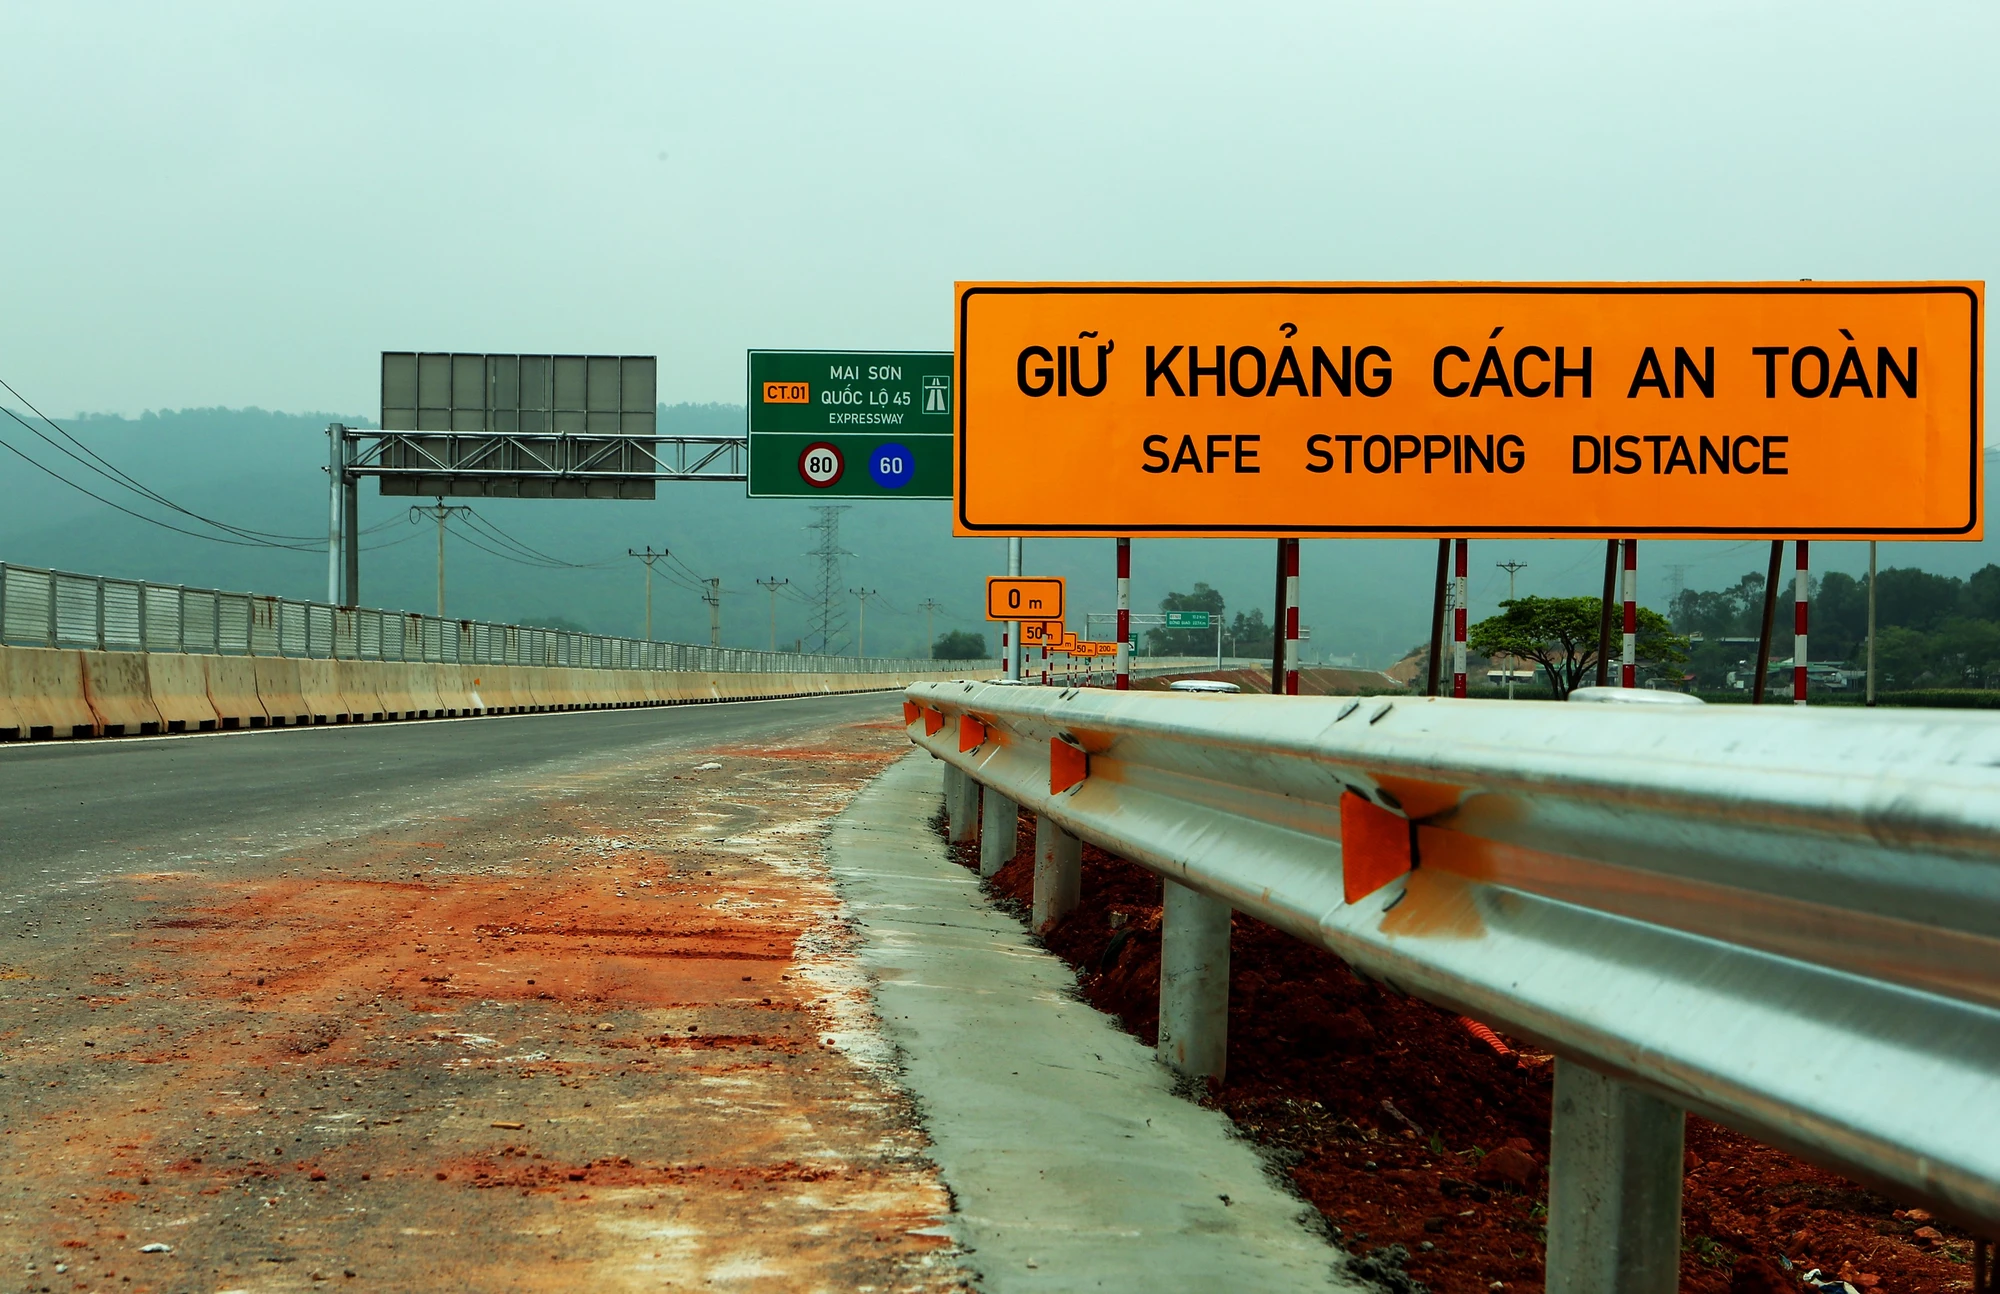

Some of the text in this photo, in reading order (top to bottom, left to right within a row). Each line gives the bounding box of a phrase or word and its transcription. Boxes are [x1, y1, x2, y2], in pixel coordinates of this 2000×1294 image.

[1016, 322, 1918, 398] GIỮ KHOẢNG CÁCH AN TOÀN
[830, 364, 902, 380] MAI SƠN
[767, 385, 806, 399] CT.01
[821, 384, 911, 408] QUỐC LỘ 45
[829, 413, 904, 424] EXPRESSWAY
[1141, 434, 1789, 475] SAFE STOPPING DISTANCE
[809, 456, 833, 474] 80
[879, 457, 903, 474] 60
[1008, 588, 1042, 609] 0 m
[1027, 626, 1042, 639] 50
